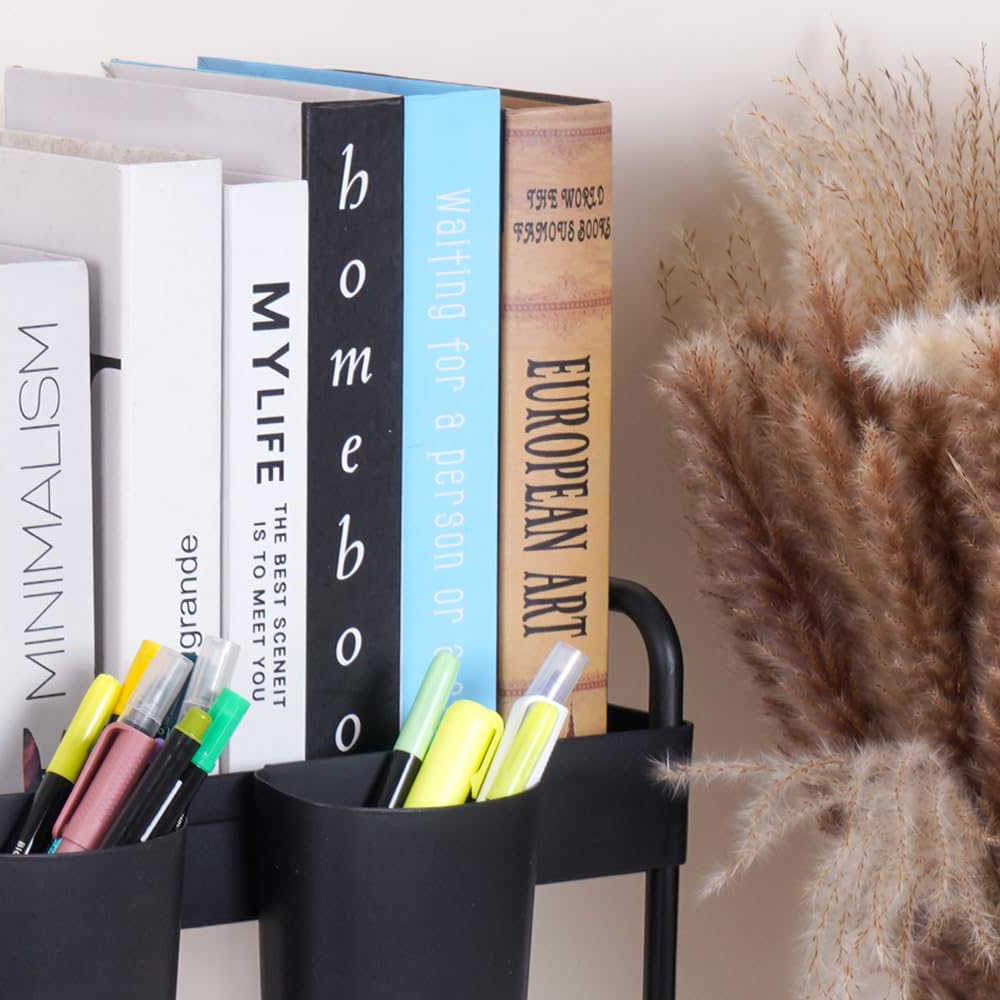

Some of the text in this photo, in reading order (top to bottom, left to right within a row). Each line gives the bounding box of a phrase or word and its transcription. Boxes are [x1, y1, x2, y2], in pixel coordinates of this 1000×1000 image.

[526, 184, 605, 211] THE WORLD
[513, 216, 611, 244] FAMOUS BOOKS
[427, 337, 470, 391] for
[435, 412, 465, 430] a
[18, 323, 67, 701] MINIMALISM
[274, 503, 288, 544] THE
[427, 448, 465, 570] person
[522, 355, 590, 638] EUROPEAN ART
[274, 553, 288, 607] BEST
[434, 588, 464, 623] or
[251, 521, 266, 702] IS TO MEET YOU
